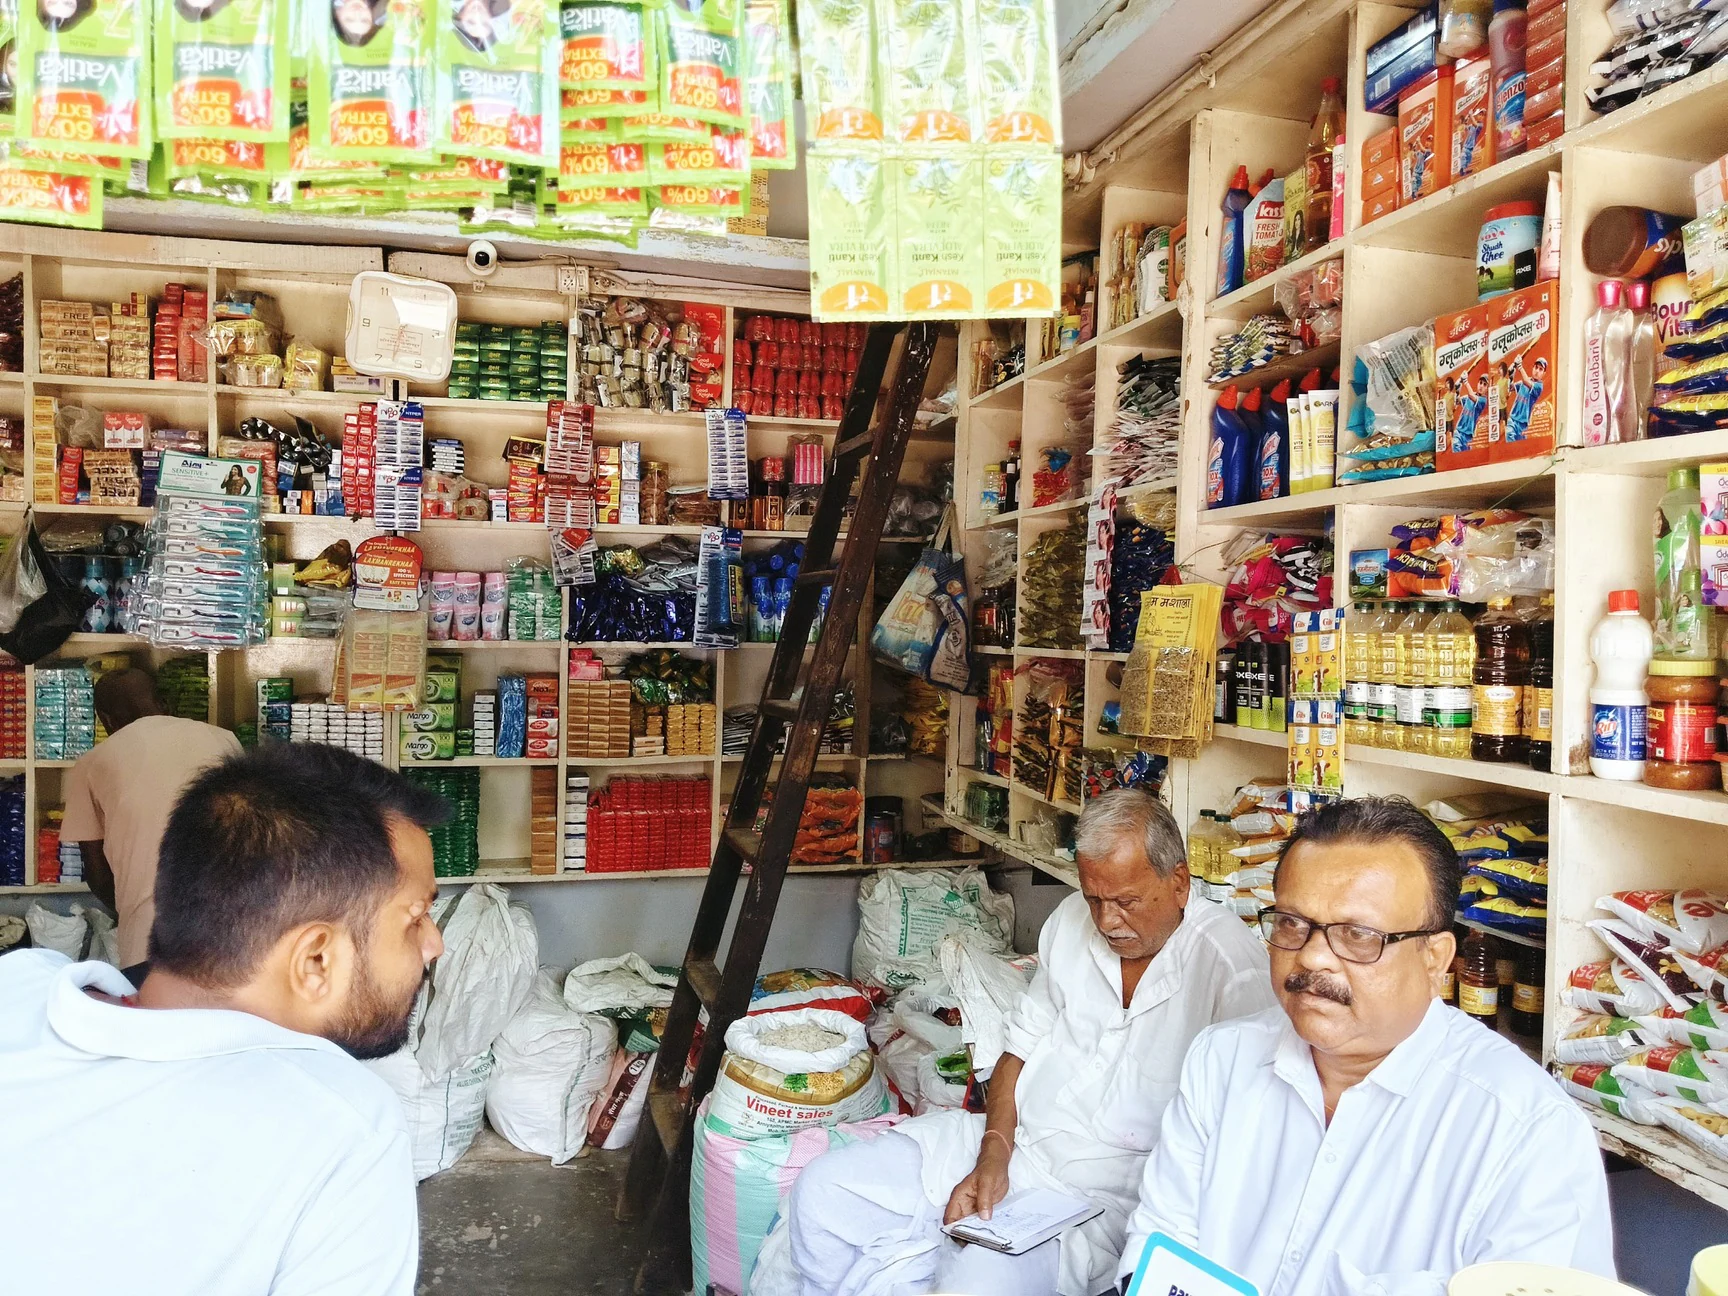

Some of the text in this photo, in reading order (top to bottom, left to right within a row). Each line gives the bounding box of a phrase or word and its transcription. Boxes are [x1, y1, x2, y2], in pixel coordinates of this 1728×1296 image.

[561, 7, 629, 36] Vatika
[177, 47, 254, 73] Vatika
[563, 48, 607, 61] EXTRA
[38, 57, 119, 87] Vatika
[565, 61, 609, 80] 60%
[336, 69, 414, 98] Vatika
[180, 91, 231, 105] EXTRA
[677, 87, 718, 109] 60%
[39, 103, 93, 120] EXTRA
[180, 106, 231, 126] 60%
[340, 111, 388, 125] EXTRA
[38, 120, 94, 140] 60%
[339, 126, 389, 146] 60%
[460, 125, 507, 146] 60%
[566, 154, 609, 173] 60%
[671, 149, 715, 168] 60%
[564, 187, 606, 200] 60%
[667, 187, 710, 204] 60%
[1256, 222, 1281, 232] FRESH
[1255, 229, 1284, 241] TOMATO
[1482, 241, 1503, 254] Shudh
[829, 253, 856, 263] Kanti
[911, 252, 965, 263] Kesh Kanti
[996, 252, 1047, 263] Kesh Kanti
[1481, 250, 1505, 264] Ghee
[380, 286, 389, 297] 11
[63, 312, 89, 320] FREE
[1651, 299, 1694, 322] Bour
[362, 317, 371, 328] 9
[63, 329, 89, 337] FREE
[374, 353, 383, 362] 7
[414, 359, 423, 369] 5
[54, 362, 80, 370] FREE
[1590, 344, 1600, 402] Gulabari
[1313, 400, 1334, 408] GARN
[406, 712, 430, 721] Margo
[405, 742, 429, 750] Margo
[898, 928, 906, 956] WITH
[746, 1095, 834, 1120] Vineet sales
